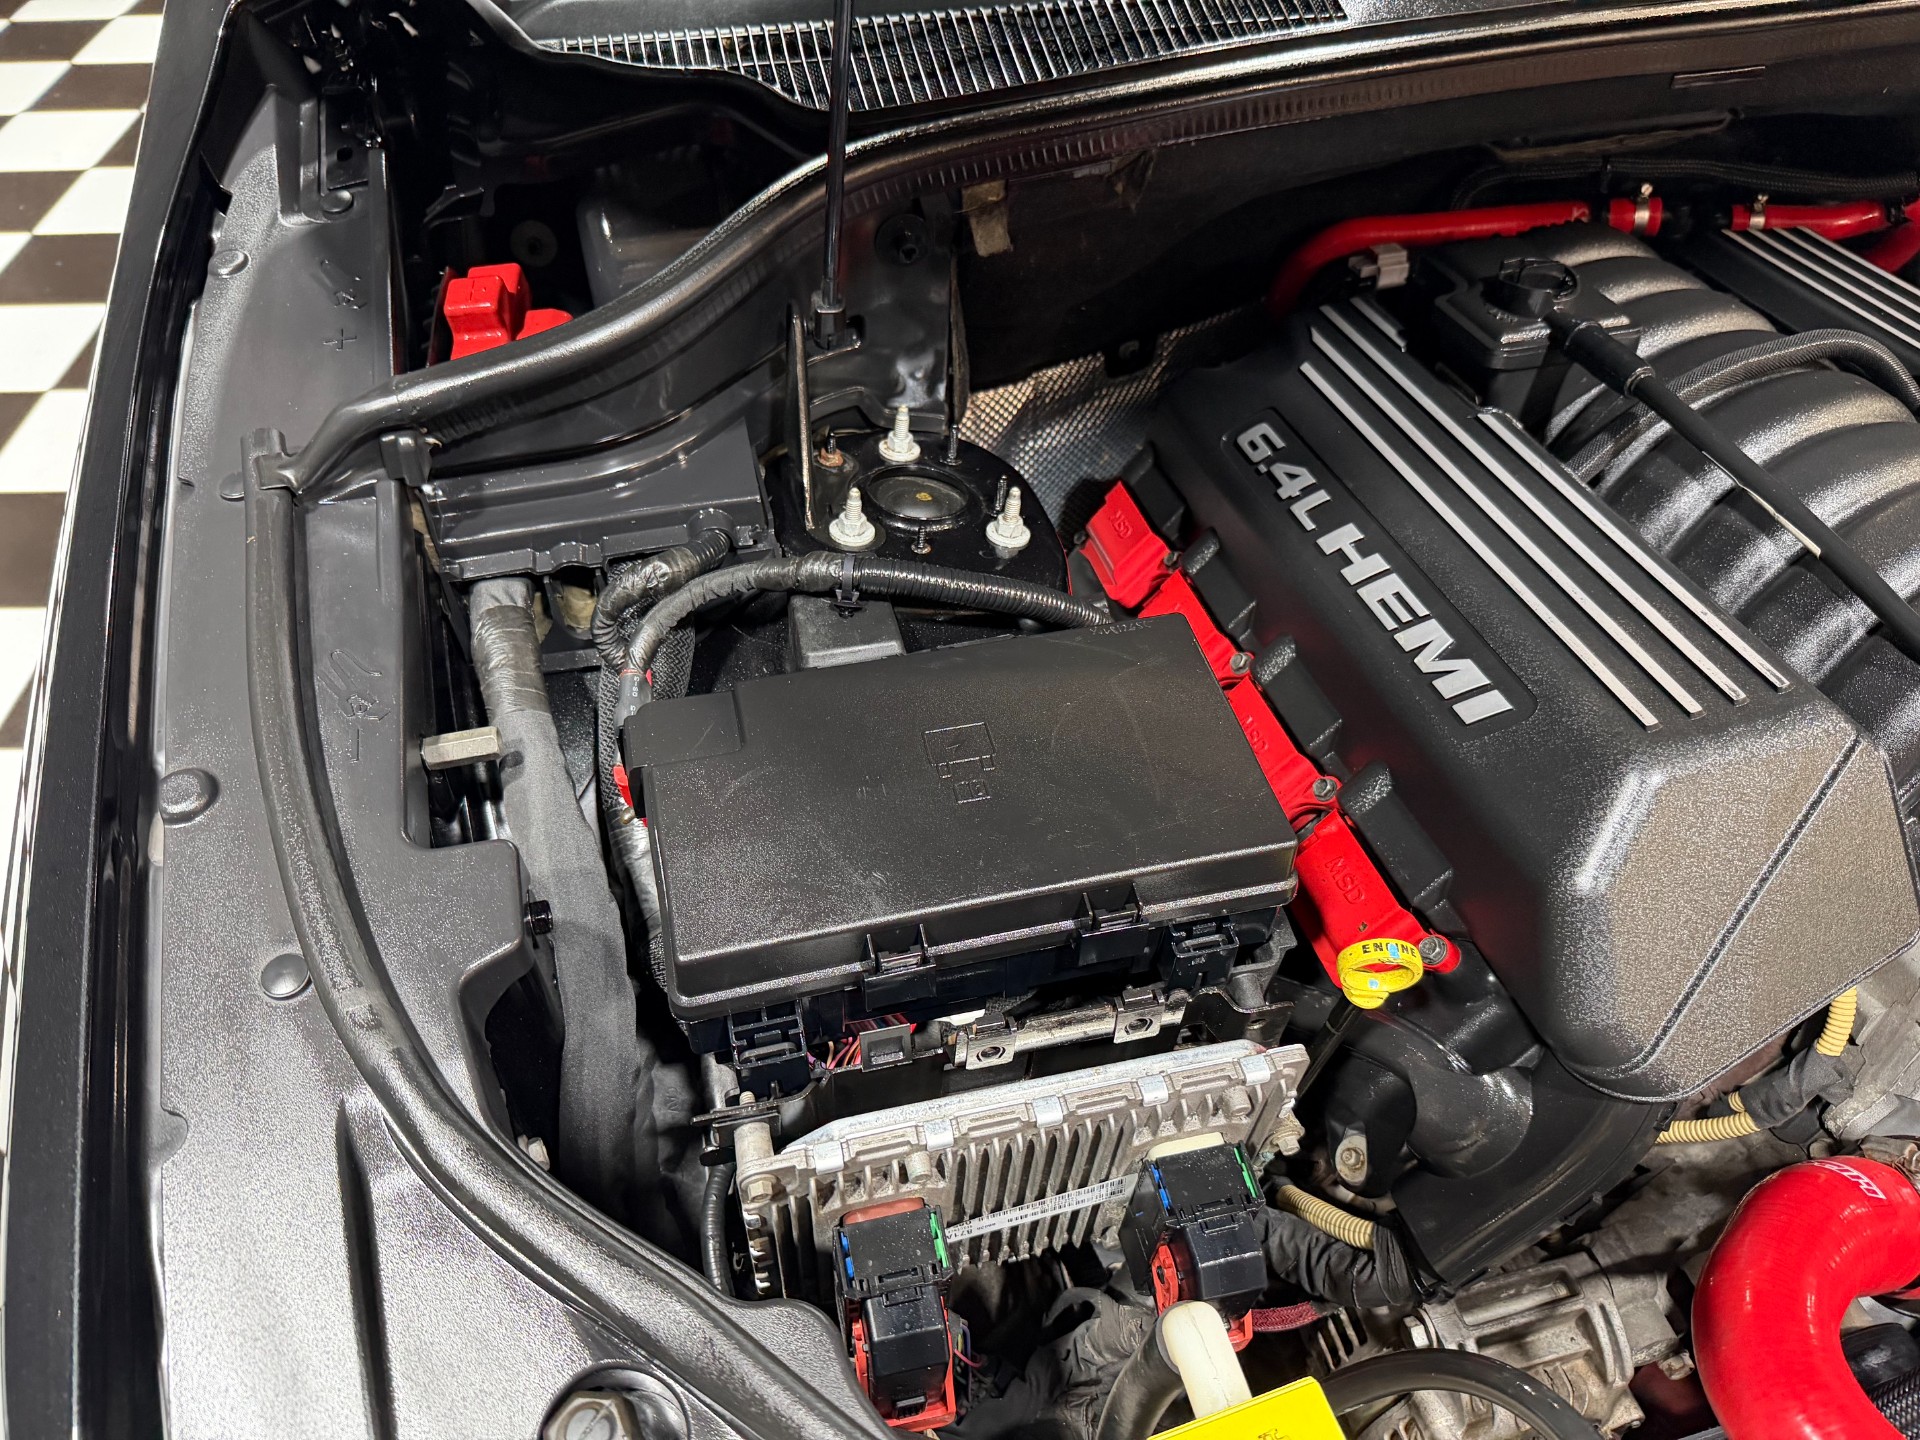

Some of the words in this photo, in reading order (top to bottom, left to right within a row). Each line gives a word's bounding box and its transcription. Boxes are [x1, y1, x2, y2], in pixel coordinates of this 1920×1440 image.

[1109, 510, 1134, 540] MSD
[1236, 422, 1331, 532] 6.4L
[1316, 522, 1514, 726] HEMI
[1240, 714, 1269, 755] MSD
[1324, 855, 1366, 905] MSD
